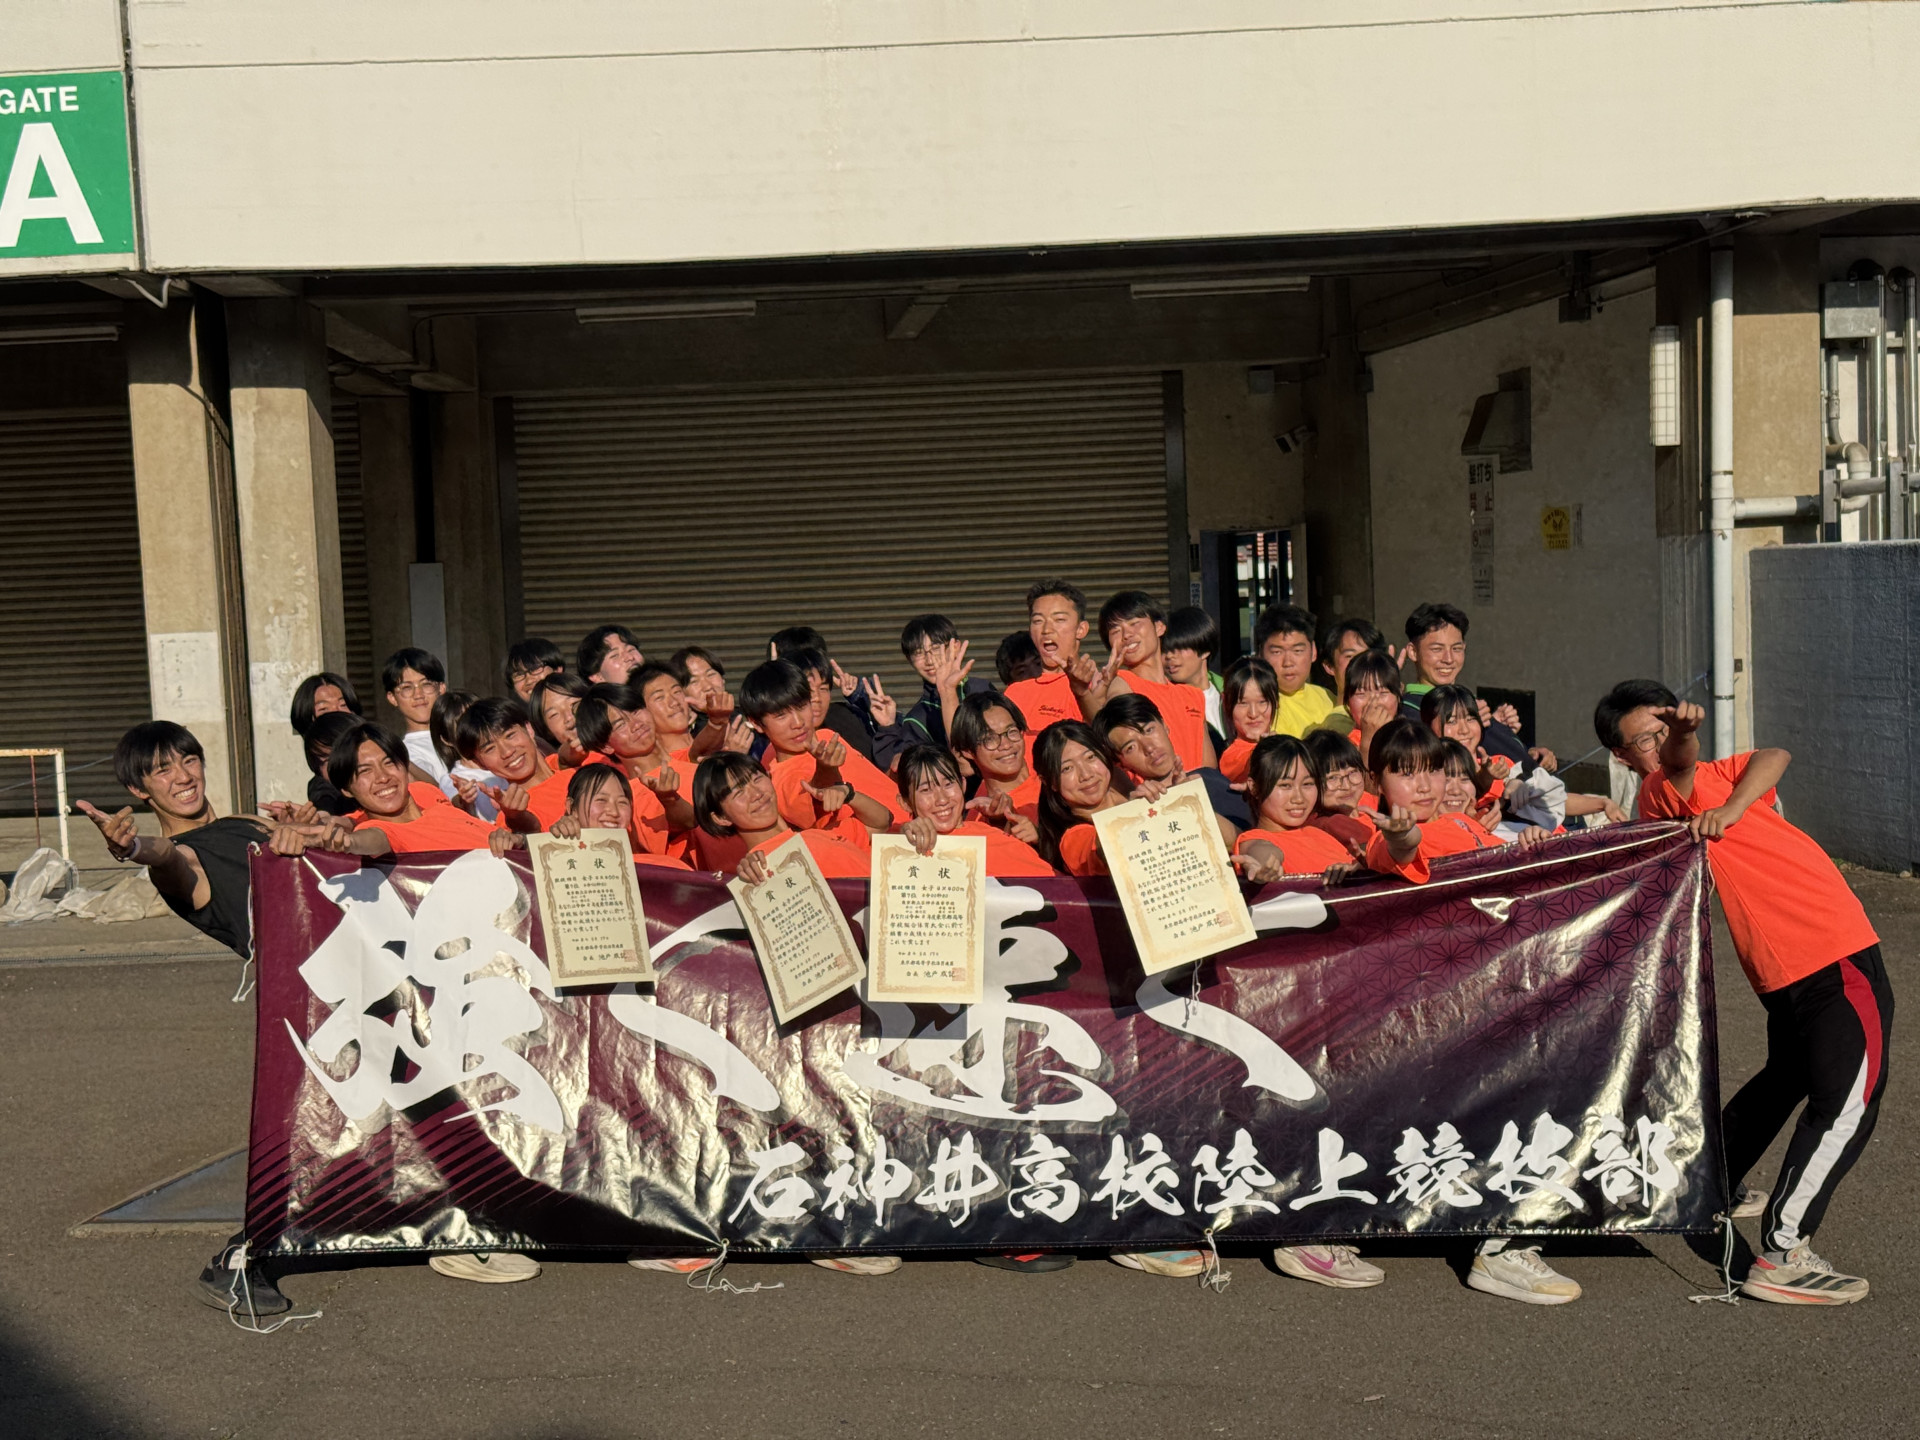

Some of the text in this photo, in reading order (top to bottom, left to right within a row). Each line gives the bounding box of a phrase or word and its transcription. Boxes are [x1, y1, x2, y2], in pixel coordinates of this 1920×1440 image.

[0, 86, 79, 114] GATE
[0, 122, 104, 247] A
[1469, 463, 1492, 484] 壁打ち
[727, 1111, 1680, 1228] 石神井高校陸上競技部
